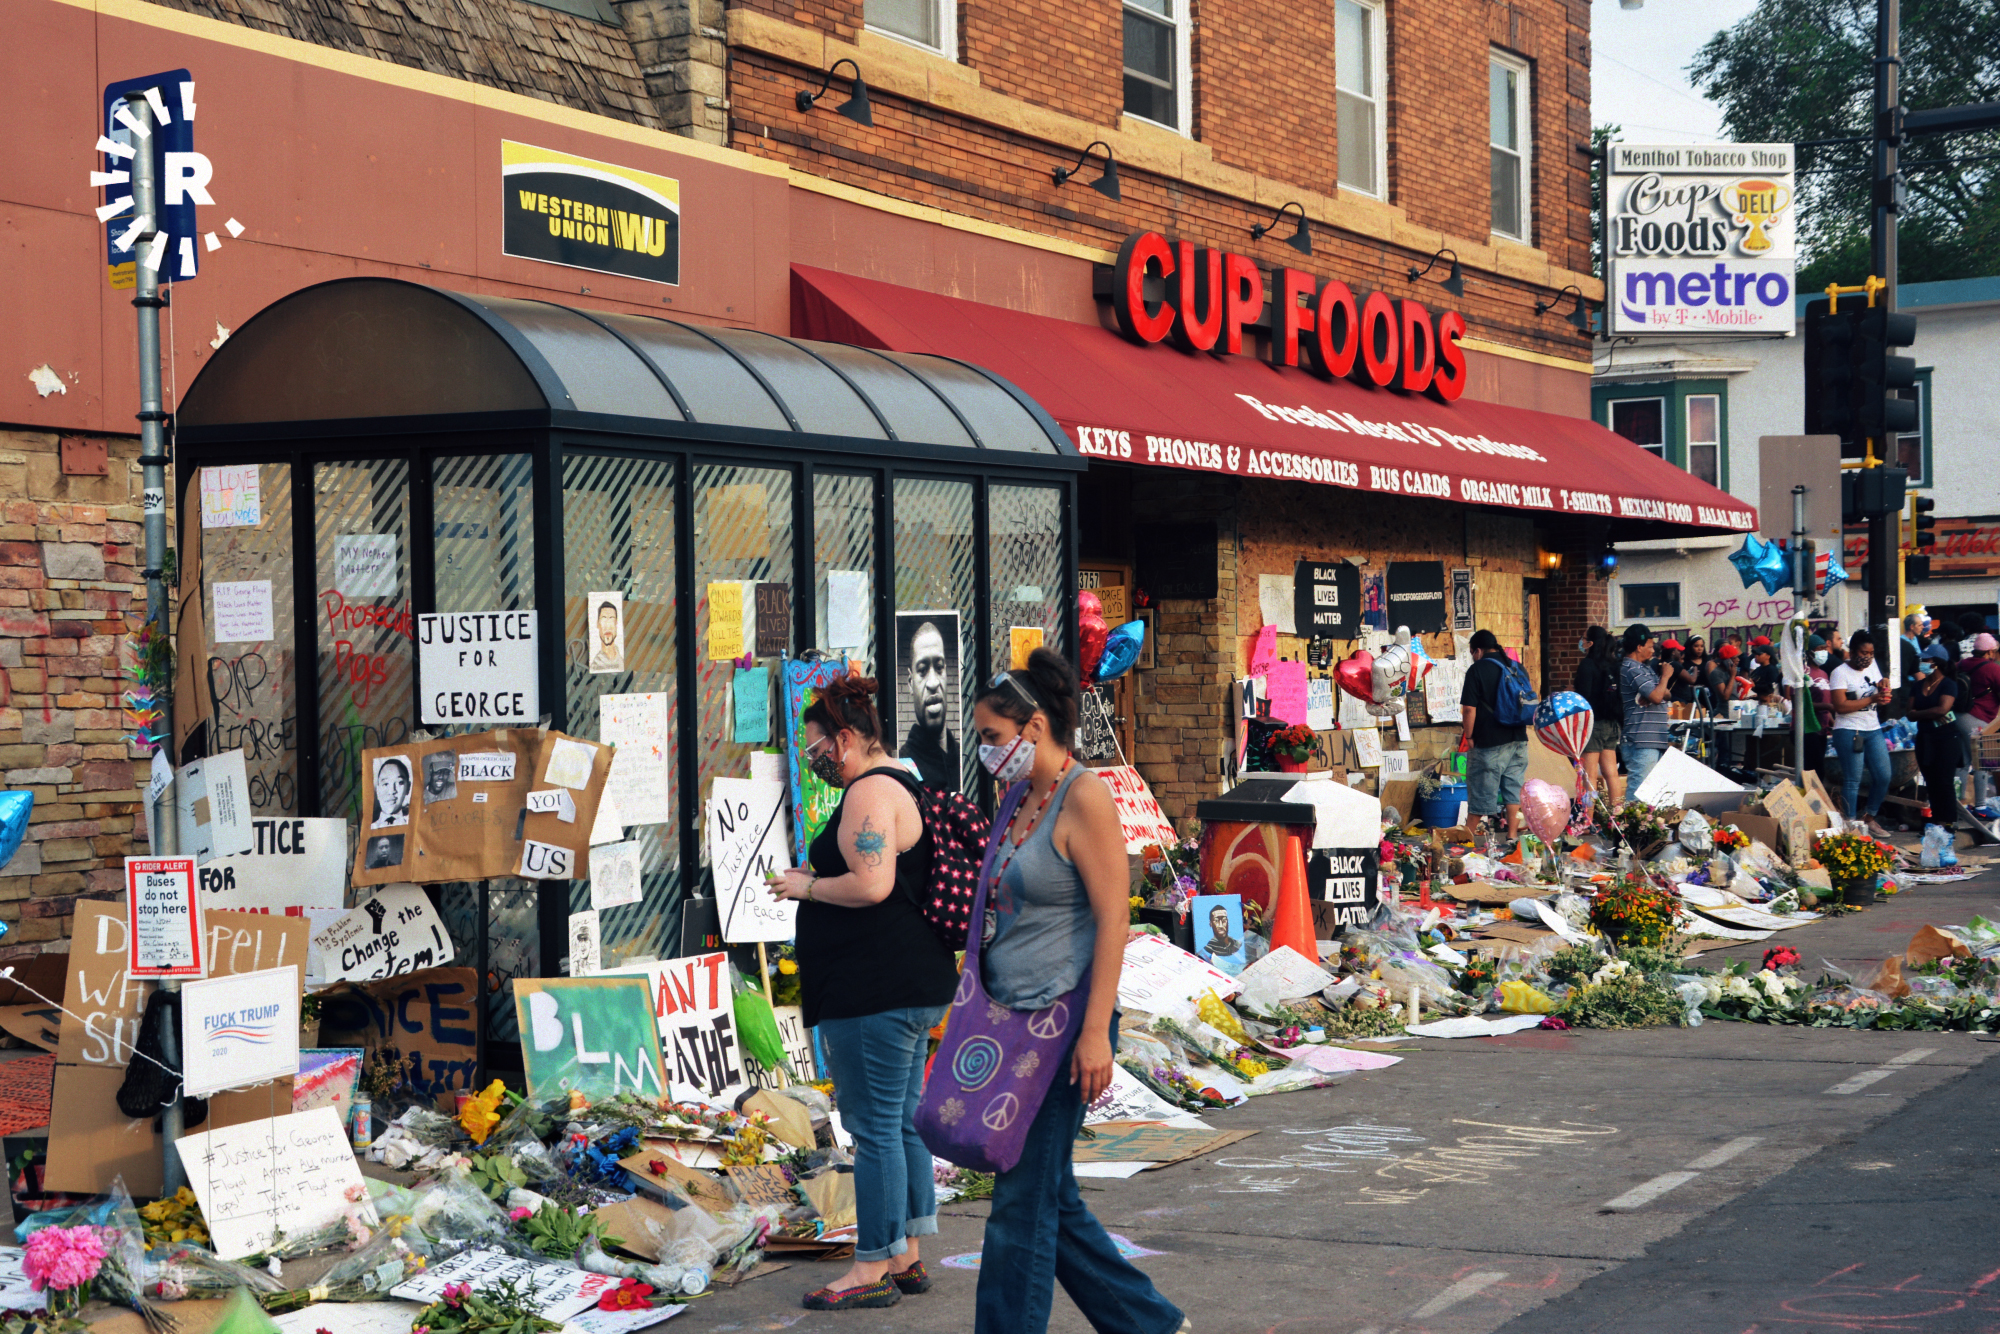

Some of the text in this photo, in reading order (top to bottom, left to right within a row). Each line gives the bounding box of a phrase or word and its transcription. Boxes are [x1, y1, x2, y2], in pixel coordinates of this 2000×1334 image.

[1621, 150, 1787, 168] Menthol Tobacco Shop
[519, 190, 608, 226] WESTERN
[1629, 174, 1774, 222] Cup DELI
[549, 216, 609, 246] UNION
[618, 211, 666, 257] WU
[1620, 216, 1727, 251] Foods
[1623, 263, 1789, 308] metro
[1126, 231, 1467, 401] CUP FOODS
[1653, 309, 1671, 328] by
[1234, 393, 1340, 432] Fresh
[218, 469, 258, 491] LOVE
[1077, 426, 1754, 529] KEYS PHONES & ACCESSORIES BUS CARDS ORGANIC MILK T-SHIRTS MEXICAN FOOD HALAL MEAT
[1079, 572, 1099, 589] 3757
[1314, 568, 1337, 581] BLACK
[757, 589, 790, 615] BLACK
[1317, 590, 1336, 603] LIVES
[421, 613, 531, 645] JUSTICE
[758, 616, 788, 633] LIVES
[1313, 612, 1342, 625] MATTER
[459, 650, 497, 667] FOR
[207, 652, 267, 715] RIP
[335, 640, 386, 708] Pigs
[436, 691, 524, 718] GEORGE
[1317, 733, 1360, 770] BLM
[1383, 755, 1403, 773] THOU
[461, 764, 514, 778] BLACK
[1098, 767, 1144, 795] TAND
[531, 794, 562, 810] YOU
[717, 799, 748, 841] No
[245, 821, 305, 856] TICE
[141, 862, 188, 871] RIDER ALERT
[527, 844, 566, 875] US
[718, 824, 763, 891] Justice
[755, 854, 774, 877] N
[1330, 856, 1365, 875] BLACK
[147, 875, 175, 887] Buses
[199, 867, 236, 893] FOR
[1333, 881, 1361, 899] LIVES
[145, 889, 178, 901] do not
[743, 886, 787, 922] Peace
[138, 902, 187, 917] stop here
[314, 935, 329, 946] The
[330, 924, 364, 947] Systemic
[342, 905, 422, 971] Change the
[352, 924, 446, 982] stem!
[656, 952, 726, 1018] AN'T
[204, 1004, 280, 1030] FUCK TRUMP
[212, 1047, 228, 1057] 2020
[530, 992, 662, 1095] BLM
[660, 1012, 742, 1097] EATHE
[209, 1176, 248, 1196] Floyd
[732, 1165, 781, 1183] BLACK
[747, 1181, 789, 1195] LIVES
[751, 1194, 799, 1207] MATTE
[400, 1277, 428, 1293] IF
